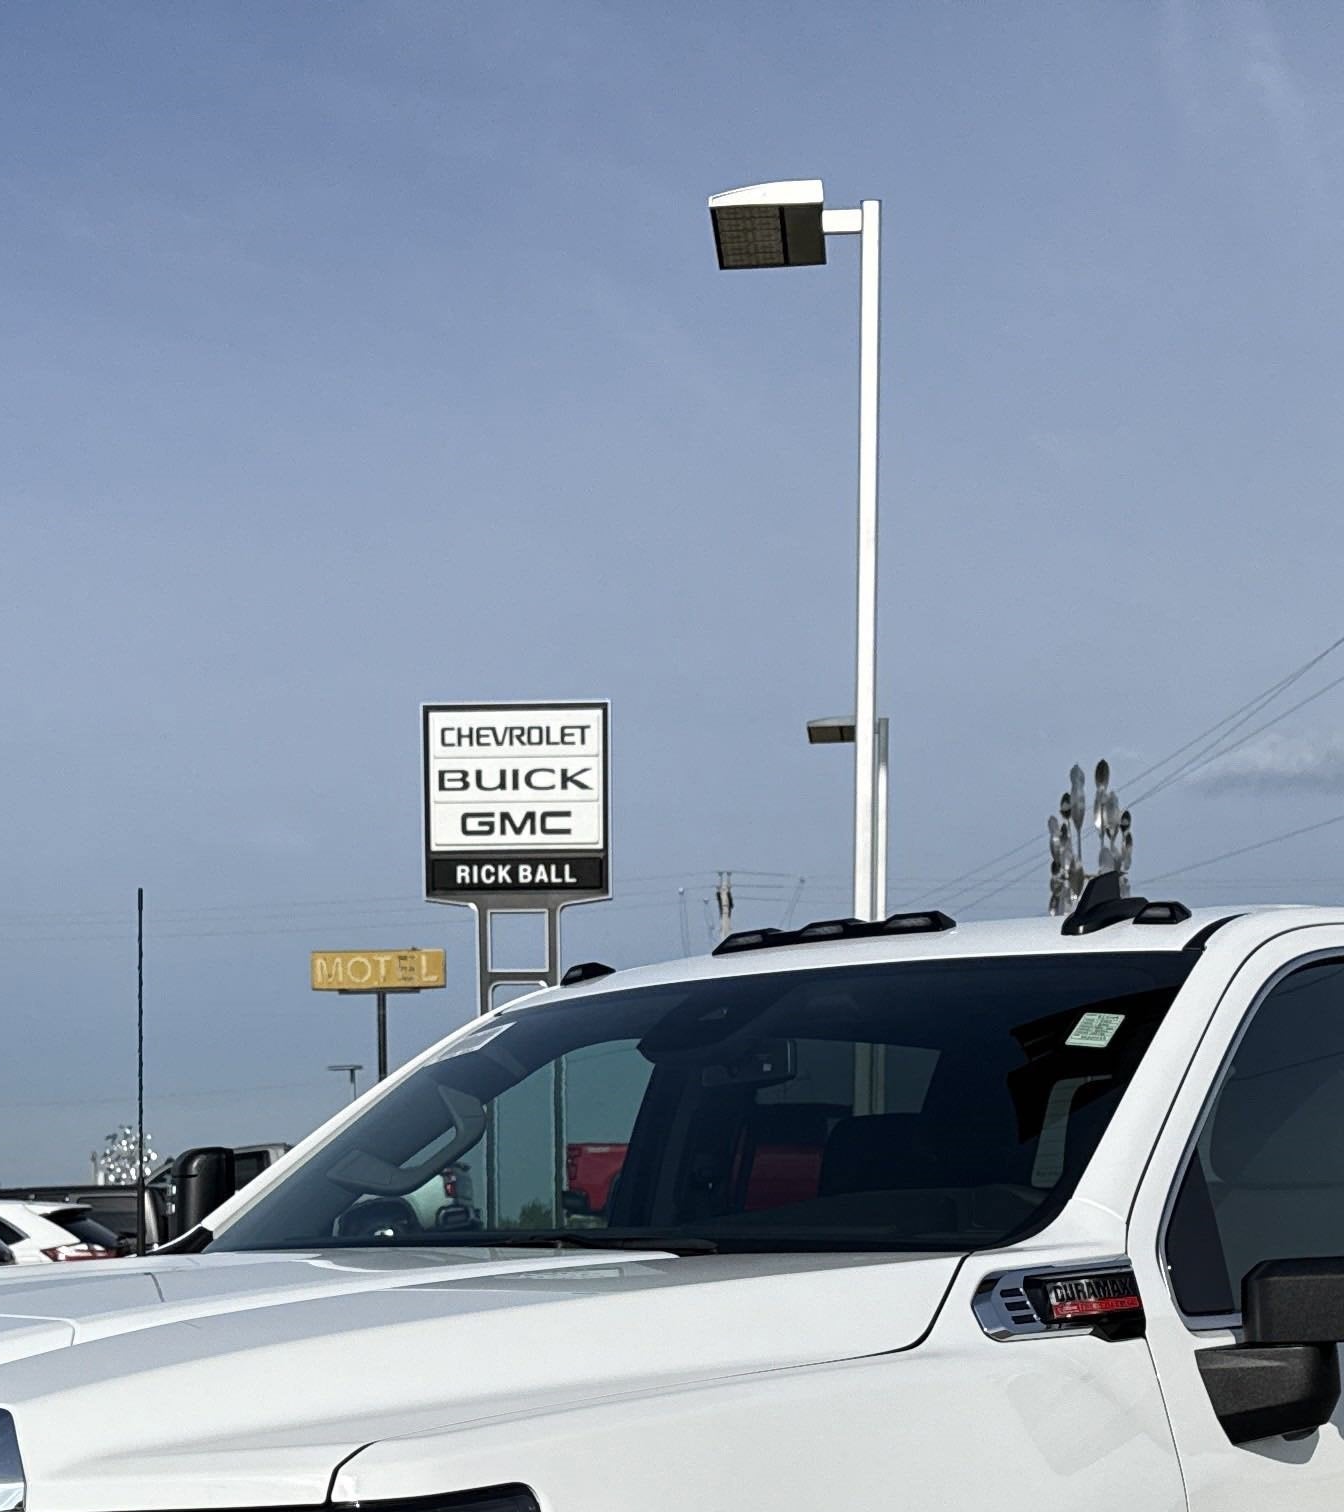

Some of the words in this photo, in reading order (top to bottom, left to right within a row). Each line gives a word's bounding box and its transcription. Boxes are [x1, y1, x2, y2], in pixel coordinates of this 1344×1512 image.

[440, 725, 591, 748] CHEVROLET
[438, 768, 594, 792] BUICK
[460, 810, 572, 837] GMC
[455, 864, 513, 885] RICK
[517, 863, 578, 884] BALL
[1050, 1278, 1134, 1303] DURAMAX
